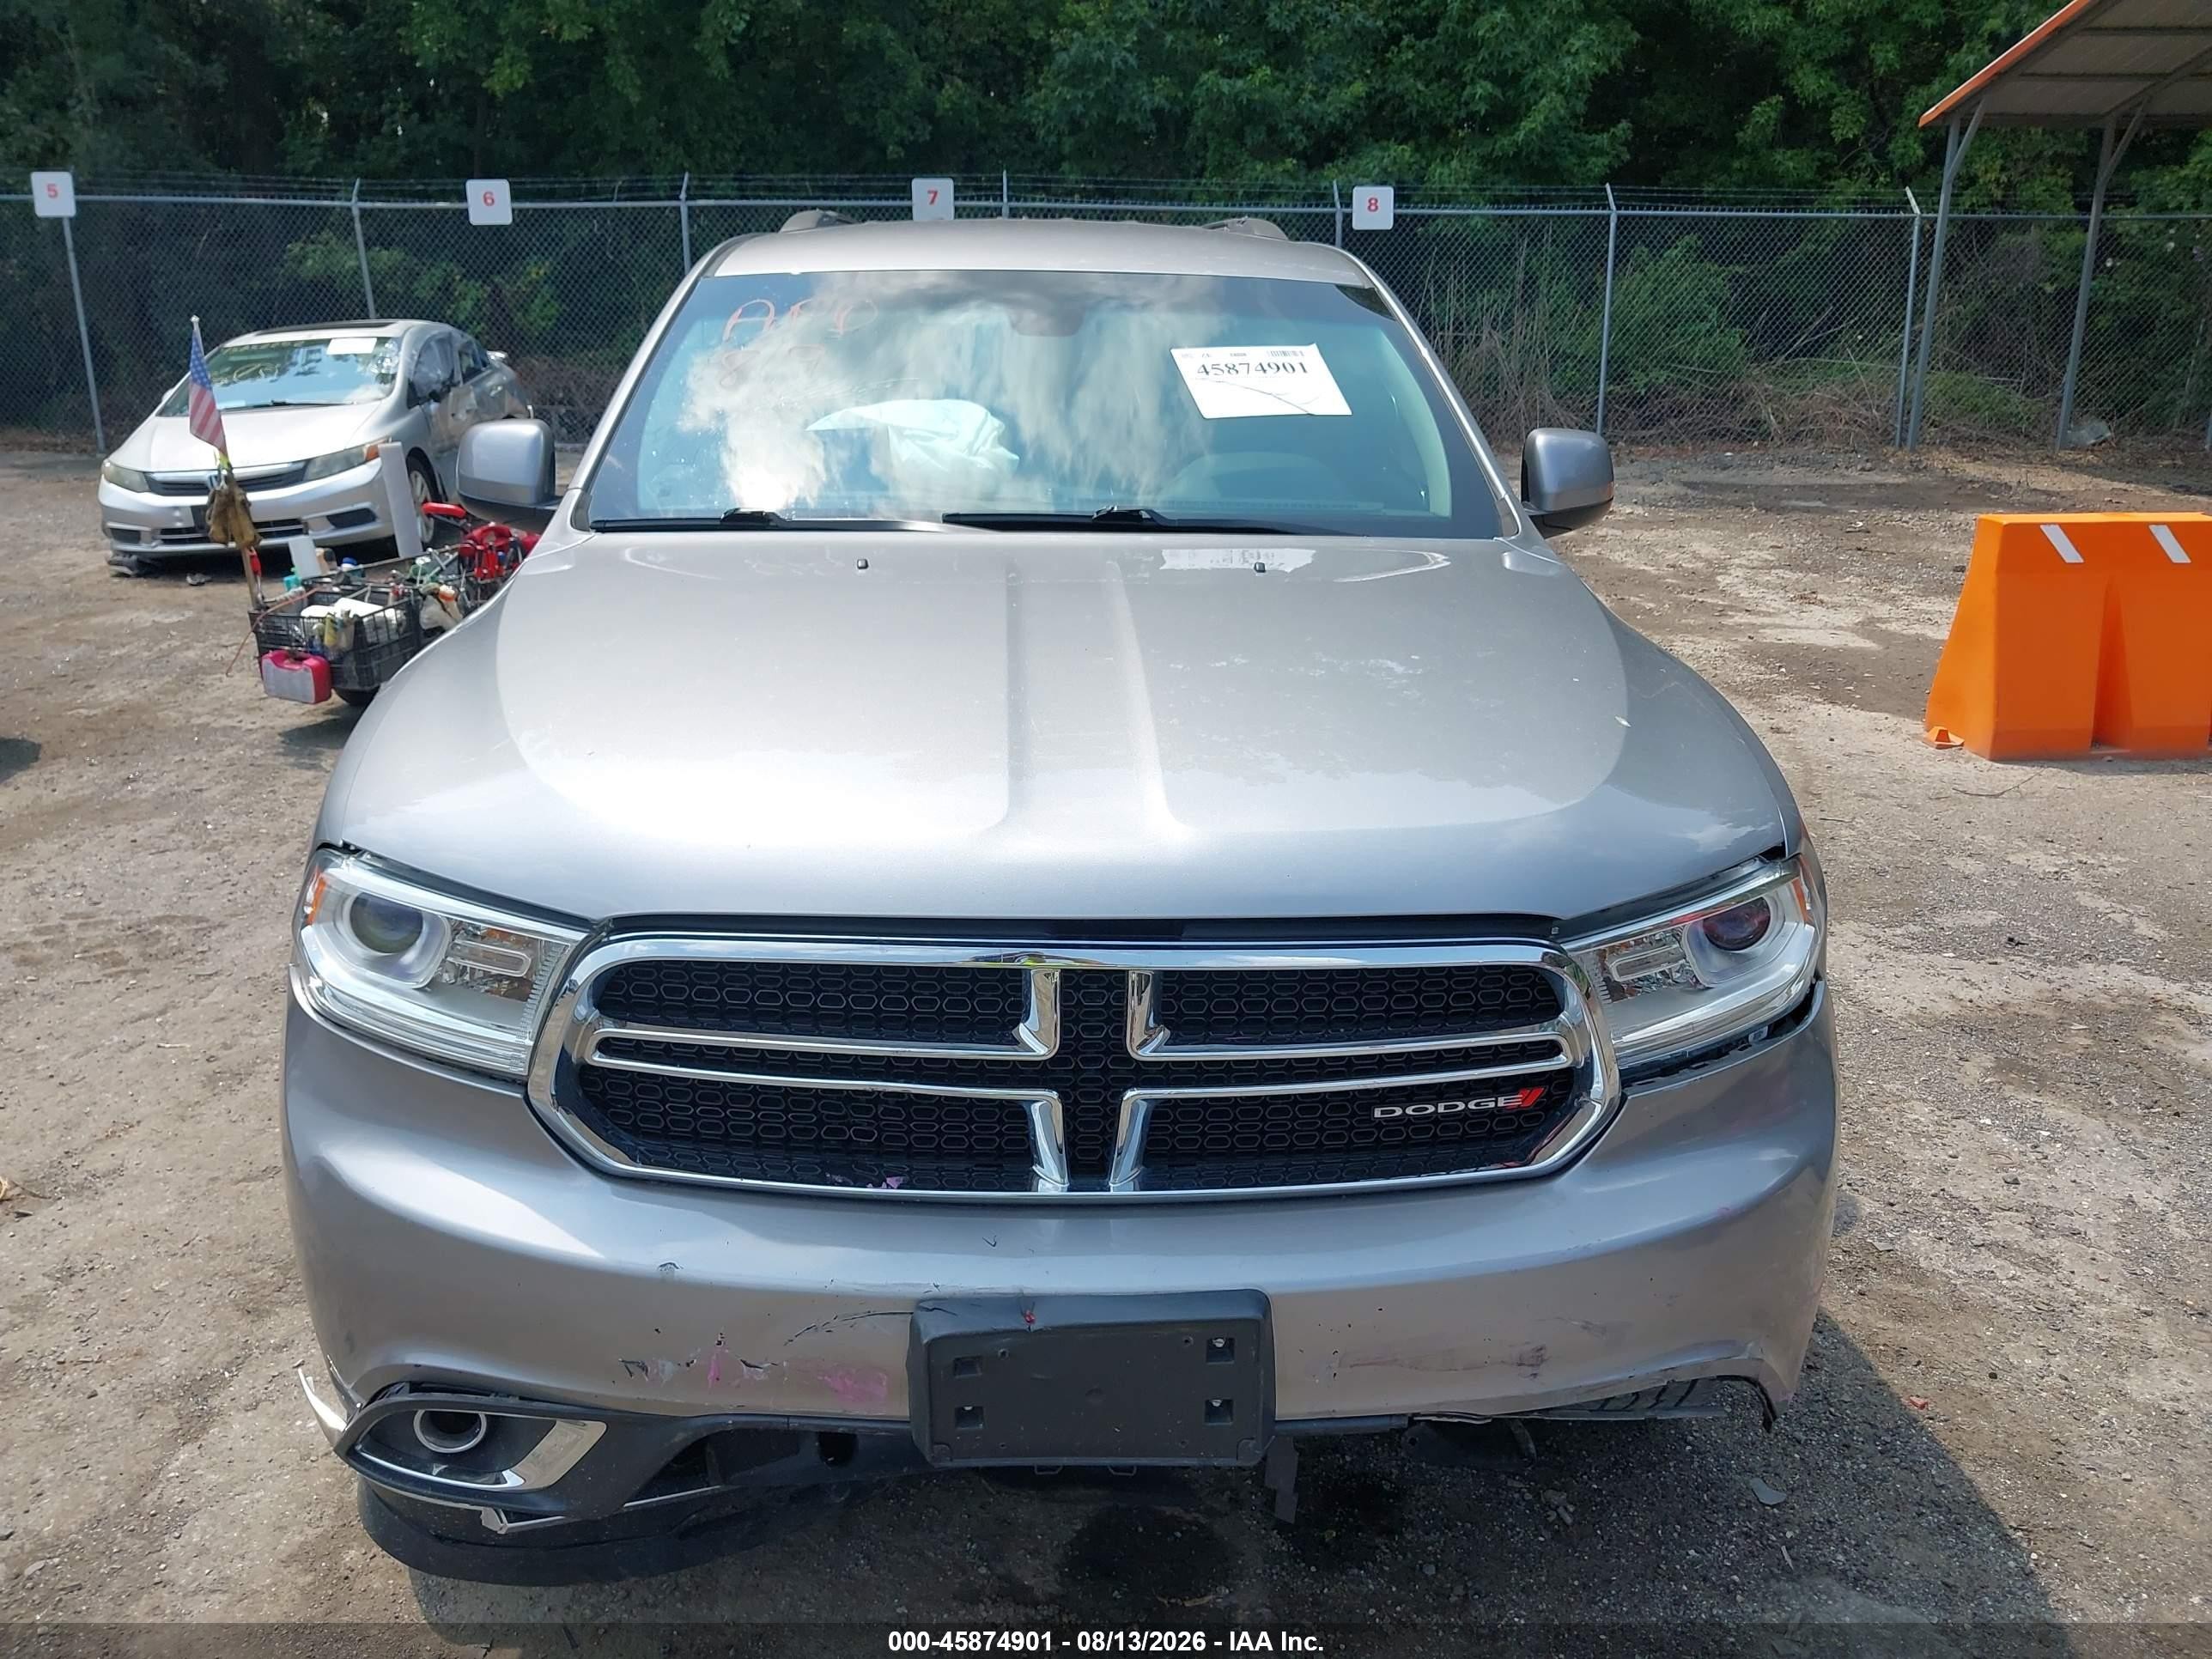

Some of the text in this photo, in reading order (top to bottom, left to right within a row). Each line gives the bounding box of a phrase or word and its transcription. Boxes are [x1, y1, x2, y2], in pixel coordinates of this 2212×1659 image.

[46, 183, 58, 198] 5
[927, 190, 939, 206] 7
[483, 191, 495, 207] 6
[1367, 197, 1379, 212] 8
[1196, 361, 1309, 376] 45874901
[1374, 1094, 1522, 1118] DODGE
